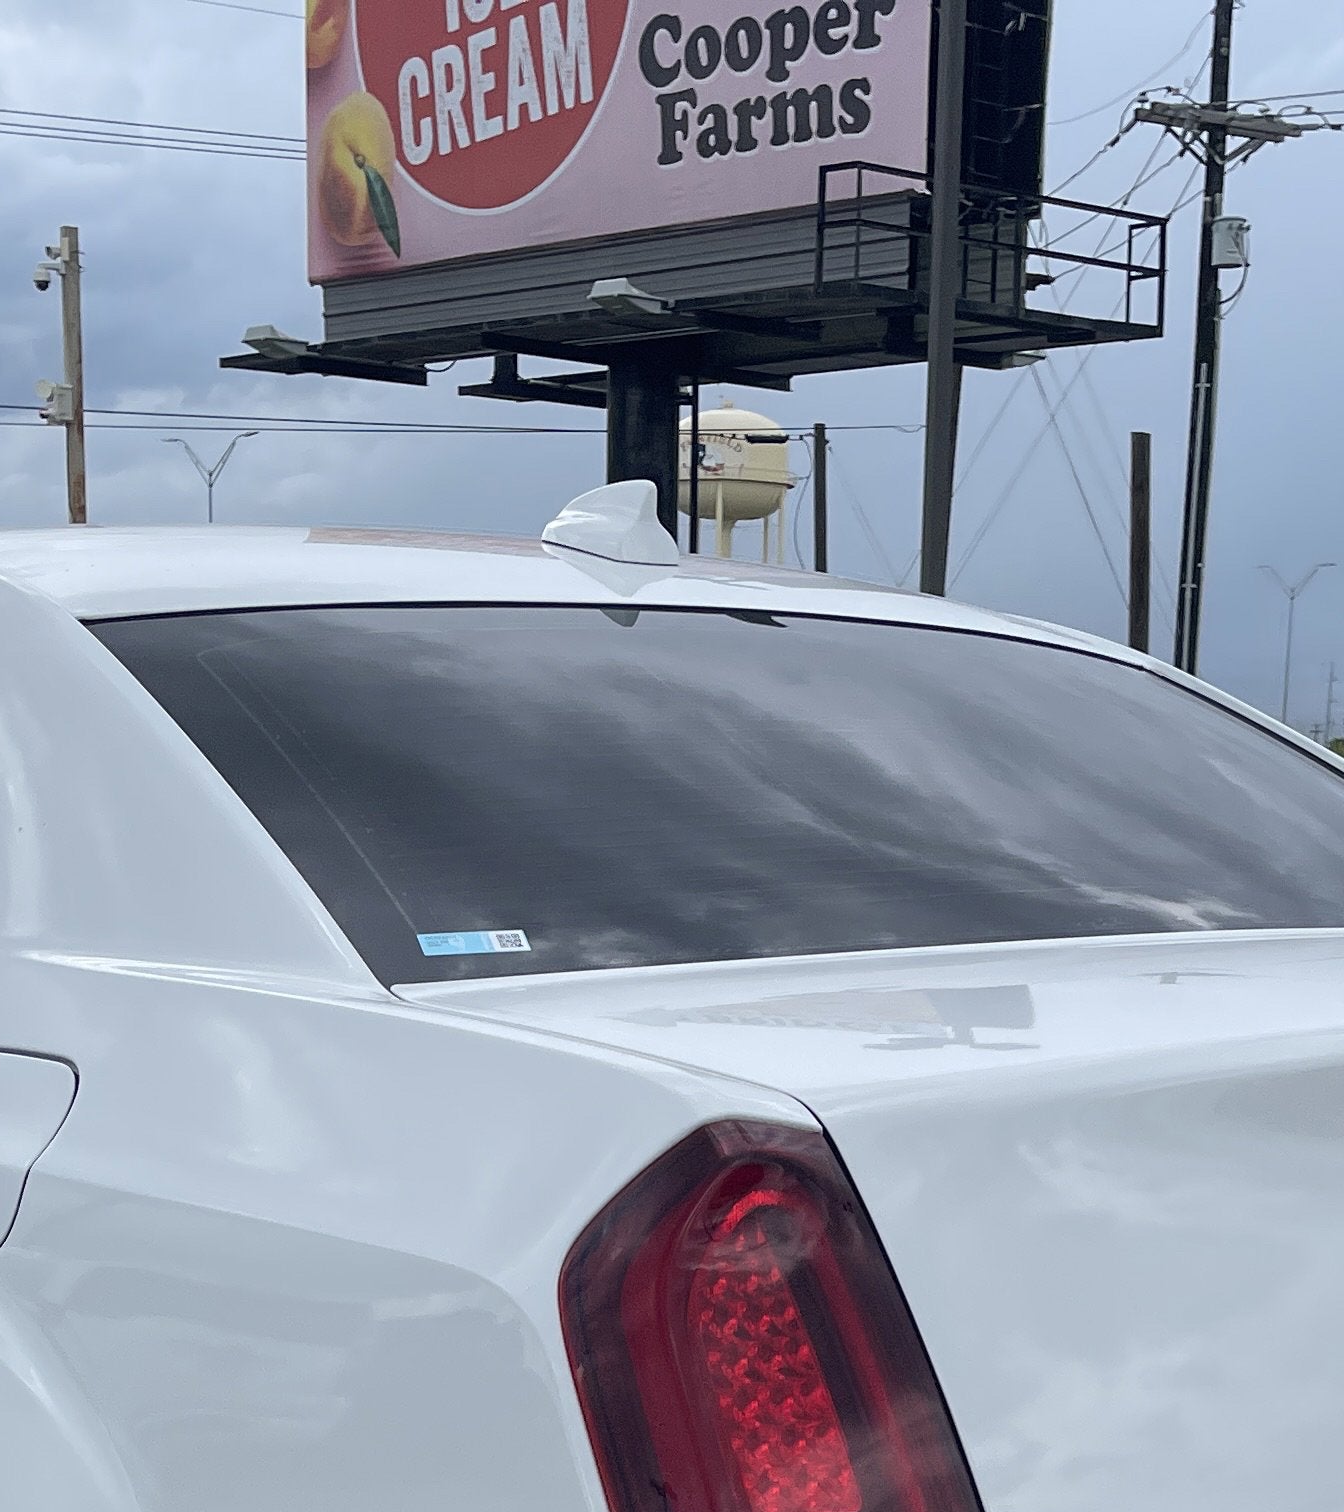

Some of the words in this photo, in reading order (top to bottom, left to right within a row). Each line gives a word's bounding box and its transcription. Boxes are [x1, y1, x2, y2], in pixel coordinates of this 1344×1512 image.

[397, 1, 594, 166] CREAM
[639, 0, 895, 87] Cooper
[656, 77, 872, 166] Farms
